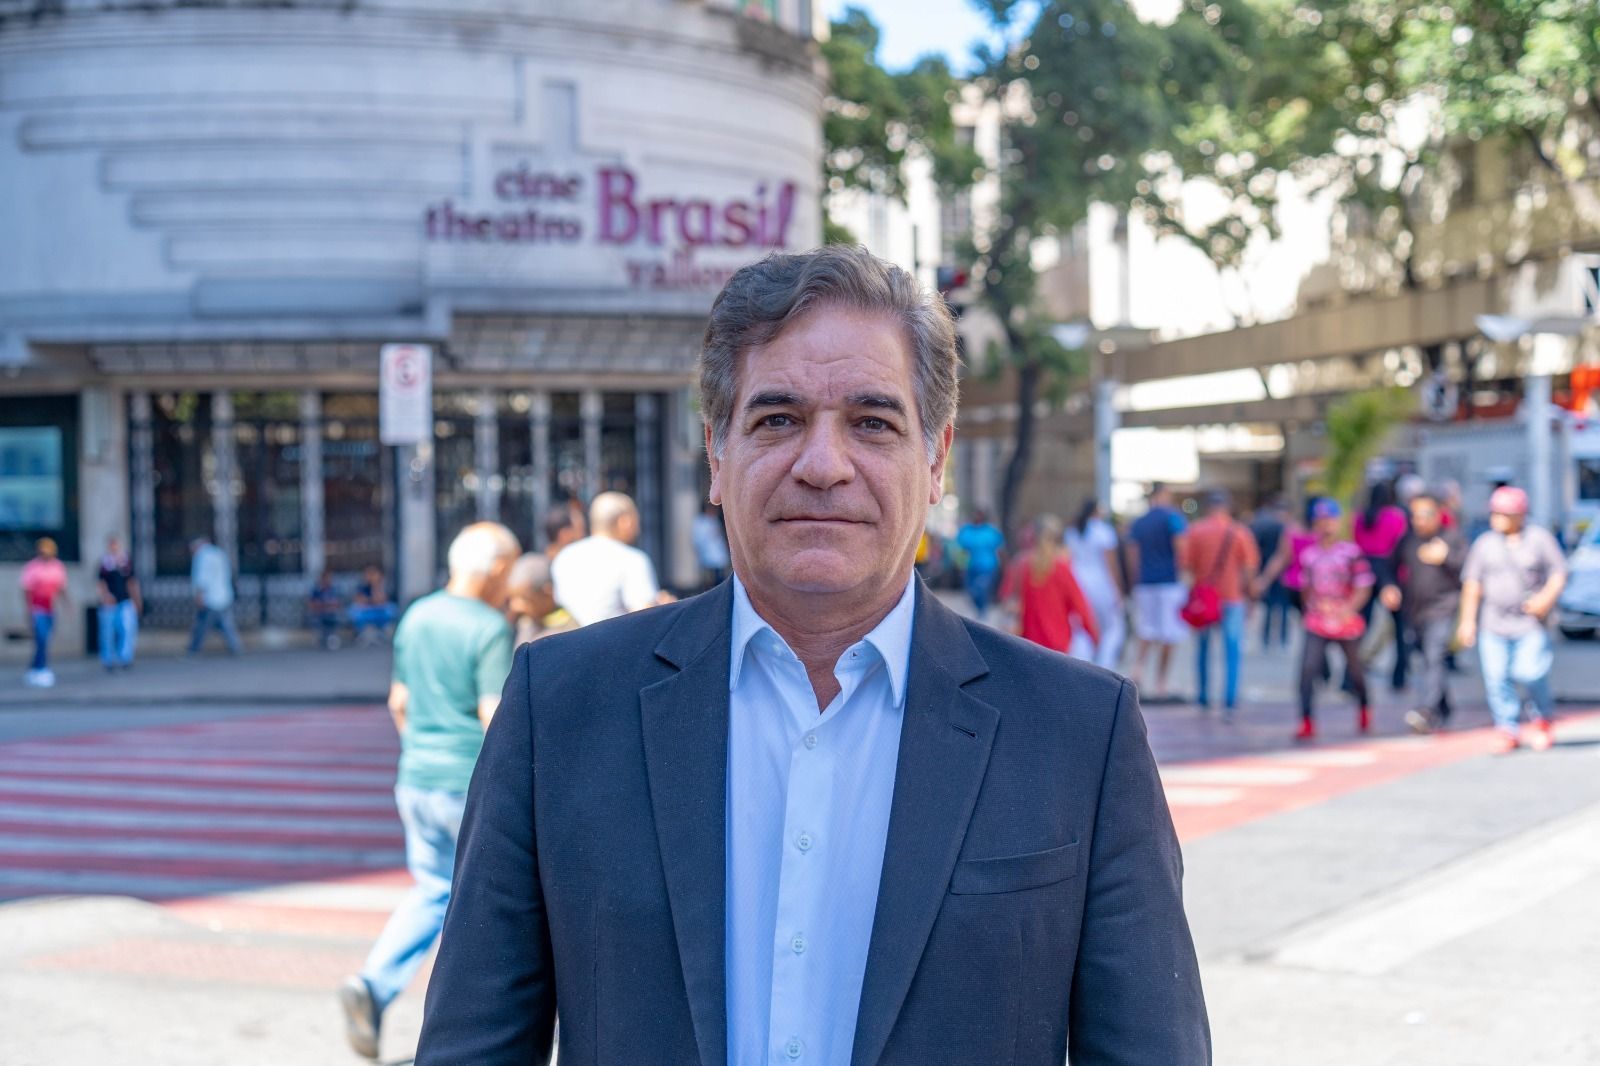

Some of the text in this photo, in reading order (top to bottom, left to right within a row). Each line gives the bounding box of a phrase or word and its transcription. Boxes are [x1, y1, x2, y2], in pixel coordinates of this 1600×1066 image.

[494, 162, 582, 200] cine
[425, 200, 583, 243] theatro
[595, 166, 797, 249] Brasil
